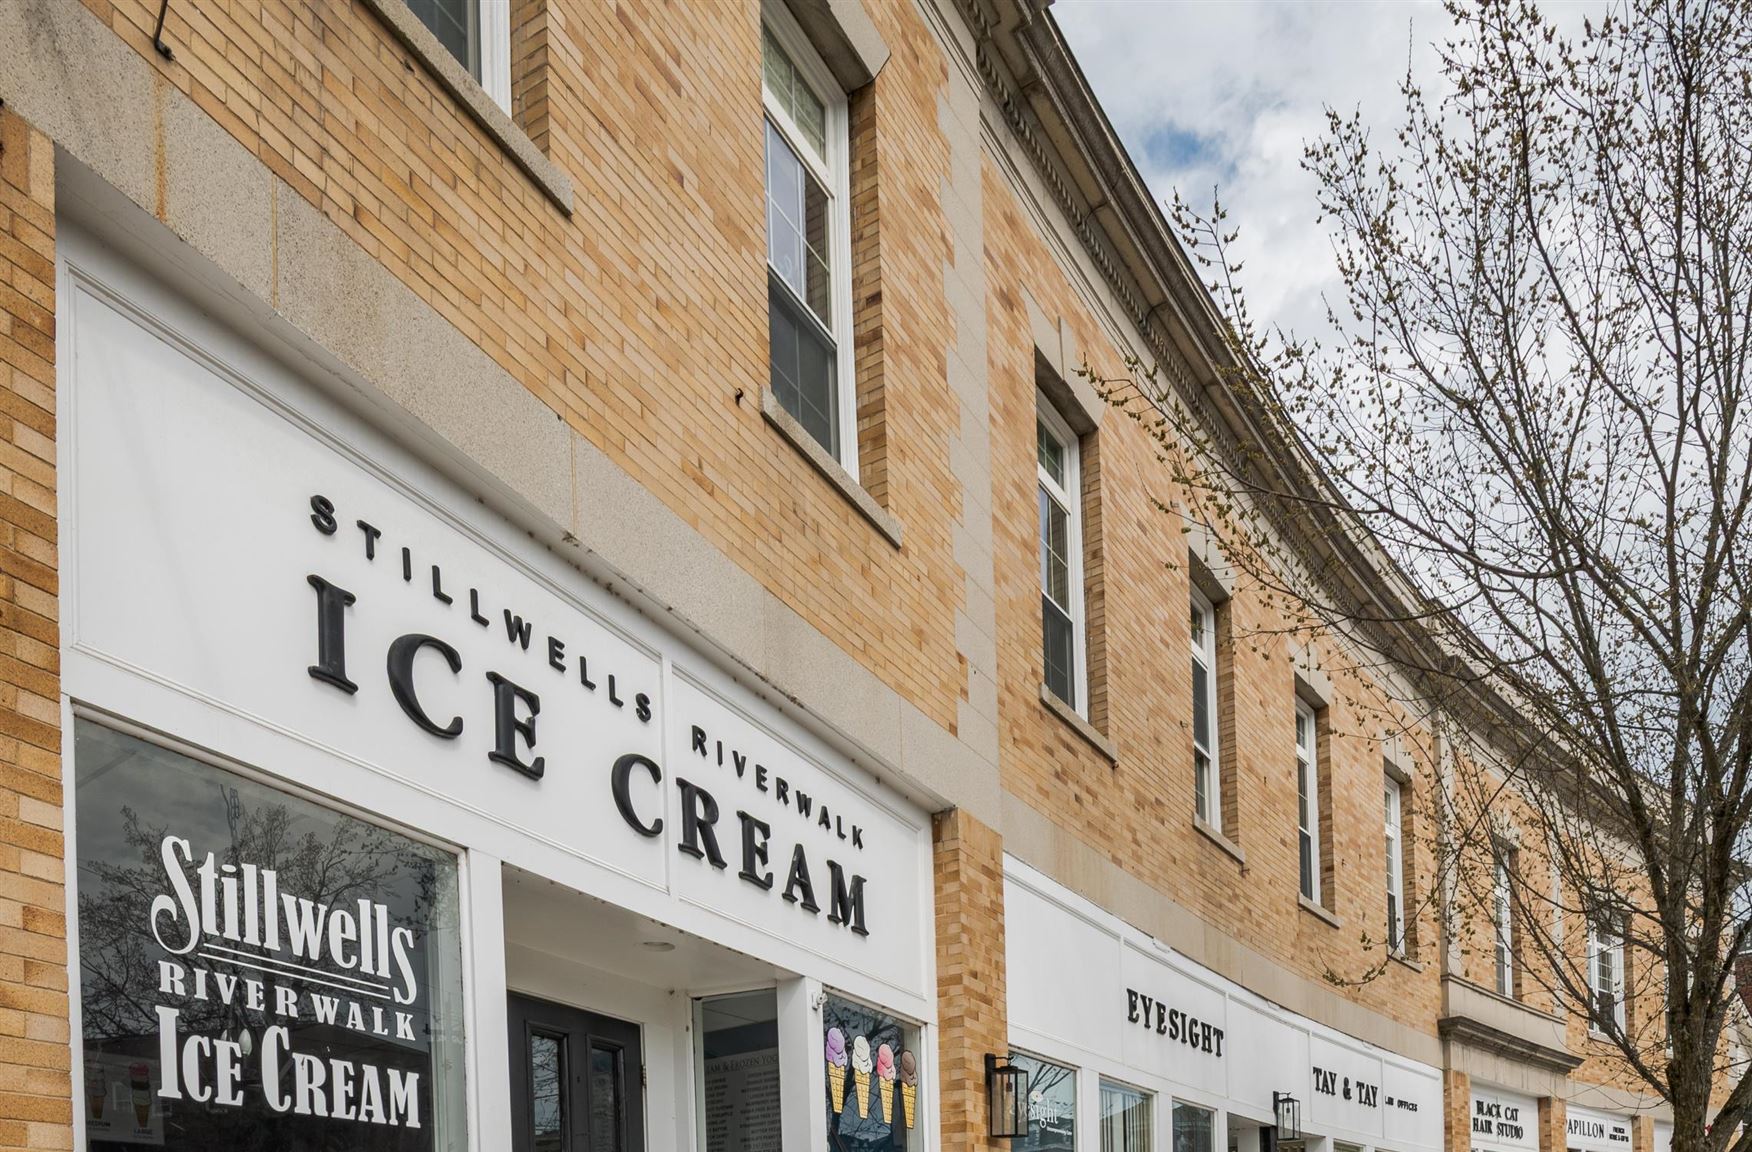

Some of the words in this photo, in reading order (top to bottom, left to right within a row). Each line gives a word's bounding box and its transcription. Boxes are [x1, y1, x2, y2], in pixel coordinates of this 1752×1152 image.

[310, 495, 652, 724] STILLWELLS
[691, 724, 866, 850] RIVERWALK
[306, 574, 546, 782] ICE
[611, 752, 870, 938] CREAM
[150, 835, 416, 1005] Stillwells
[1126, 988, 1225, 1058] EYESIGHT
[155, 1005, 245, 1106] ICE
[261, 1025, 422, 1129] CREAM
[1312, 1066, 1337, 1096] TAY
[1342, 1077, 1352, 1101] &
[1356, 1080, 1378, 1108] TAY
[1472, 1117, 1493, 1134] HAIR
[1496, 1122, 1524, 1139] STUDIO
[1476, 1100, 1502, 1119] BLACK
[1504, 1106, 1519, 1121] CAT
[1566, 1118, 1605, 1138] APILLON
